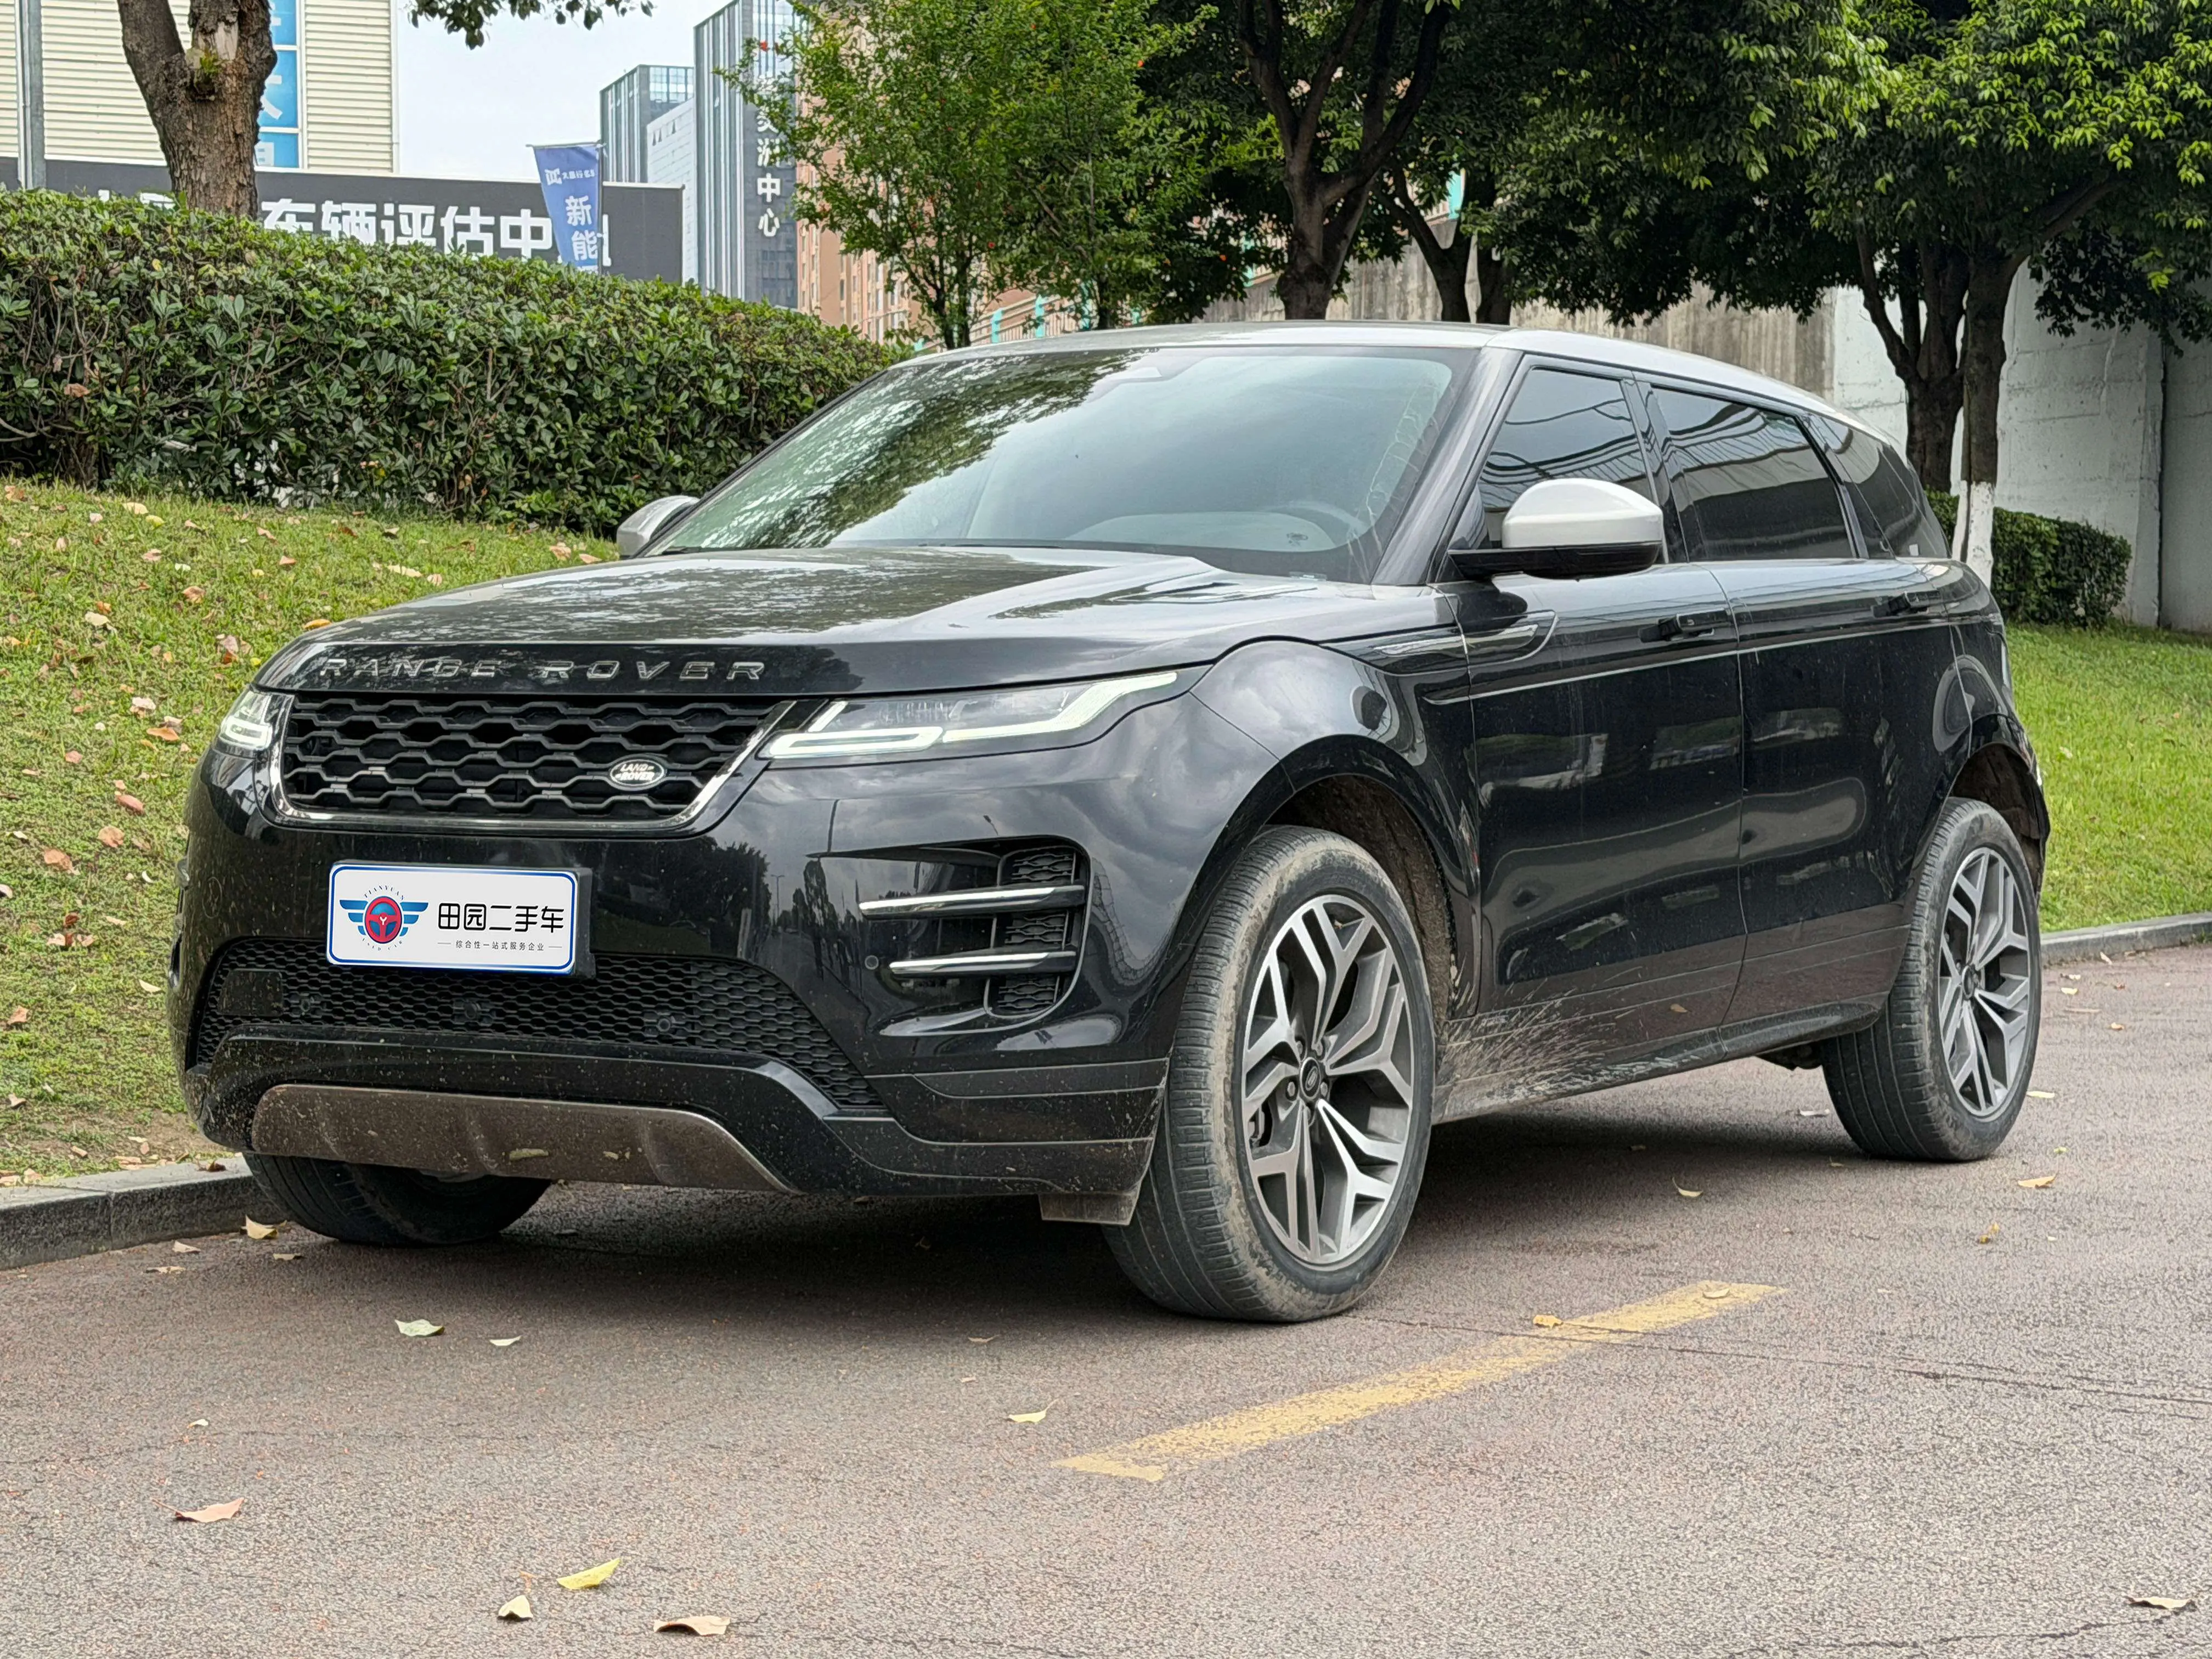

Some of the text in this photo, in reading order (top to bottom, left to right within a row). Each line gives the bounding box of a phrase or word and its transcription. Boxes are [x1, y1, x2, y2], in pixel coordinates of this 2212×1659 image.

[565, 195, 599, 273] 新能
[320, 658, 765, 680] RANGE ROVER
[620, 763, 648, 772] LAND
[620, 771, 655, 781] ROVER
[438, 902, 565, 933] 田园二手车
[456, 939, 544, 951] 综合性一站式服务企业
